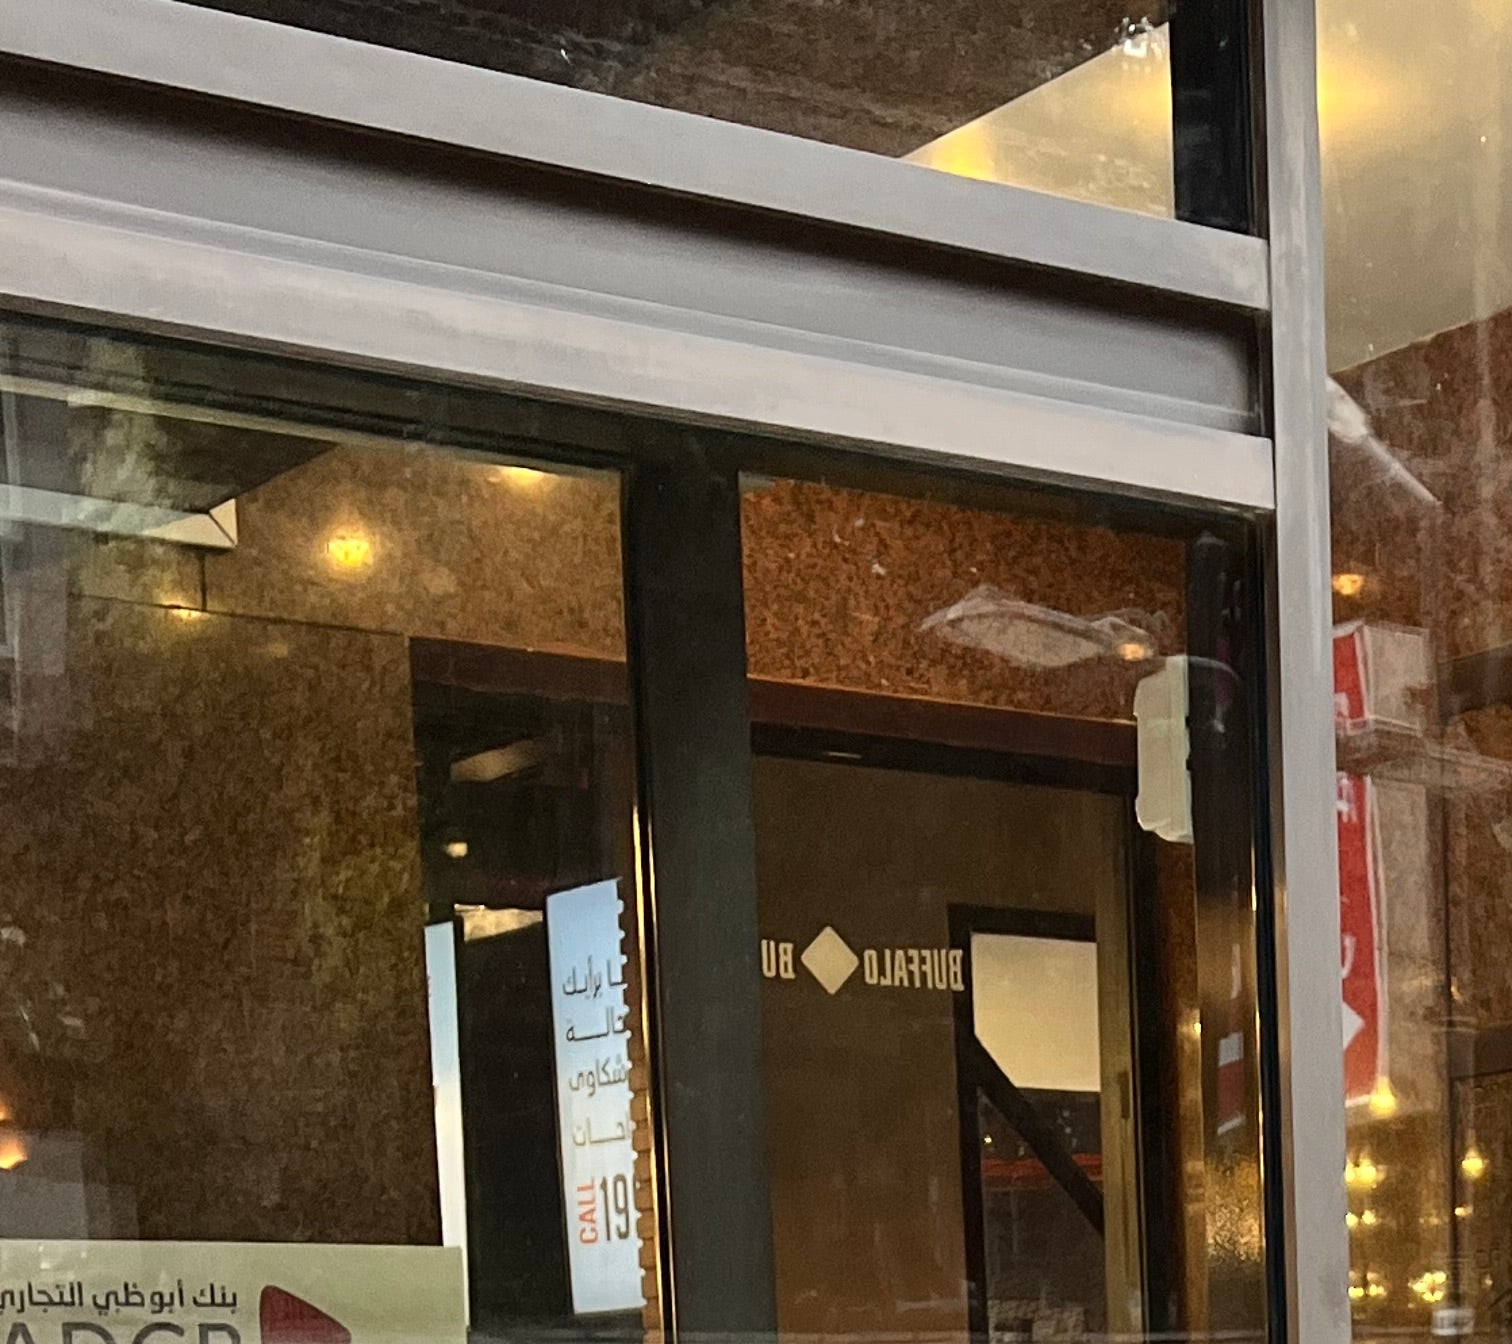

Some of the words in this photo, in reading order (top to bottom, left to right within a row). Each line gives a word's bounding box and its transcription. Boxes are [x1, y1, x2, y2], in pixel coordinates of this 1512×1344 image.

[577, 1175, 599, 1244] CALL
[600, 1173, 637, 1242] 19
[92, 1278, 185, 1317] أبوظبي
[193, 1282, 238, 1314] بنك
